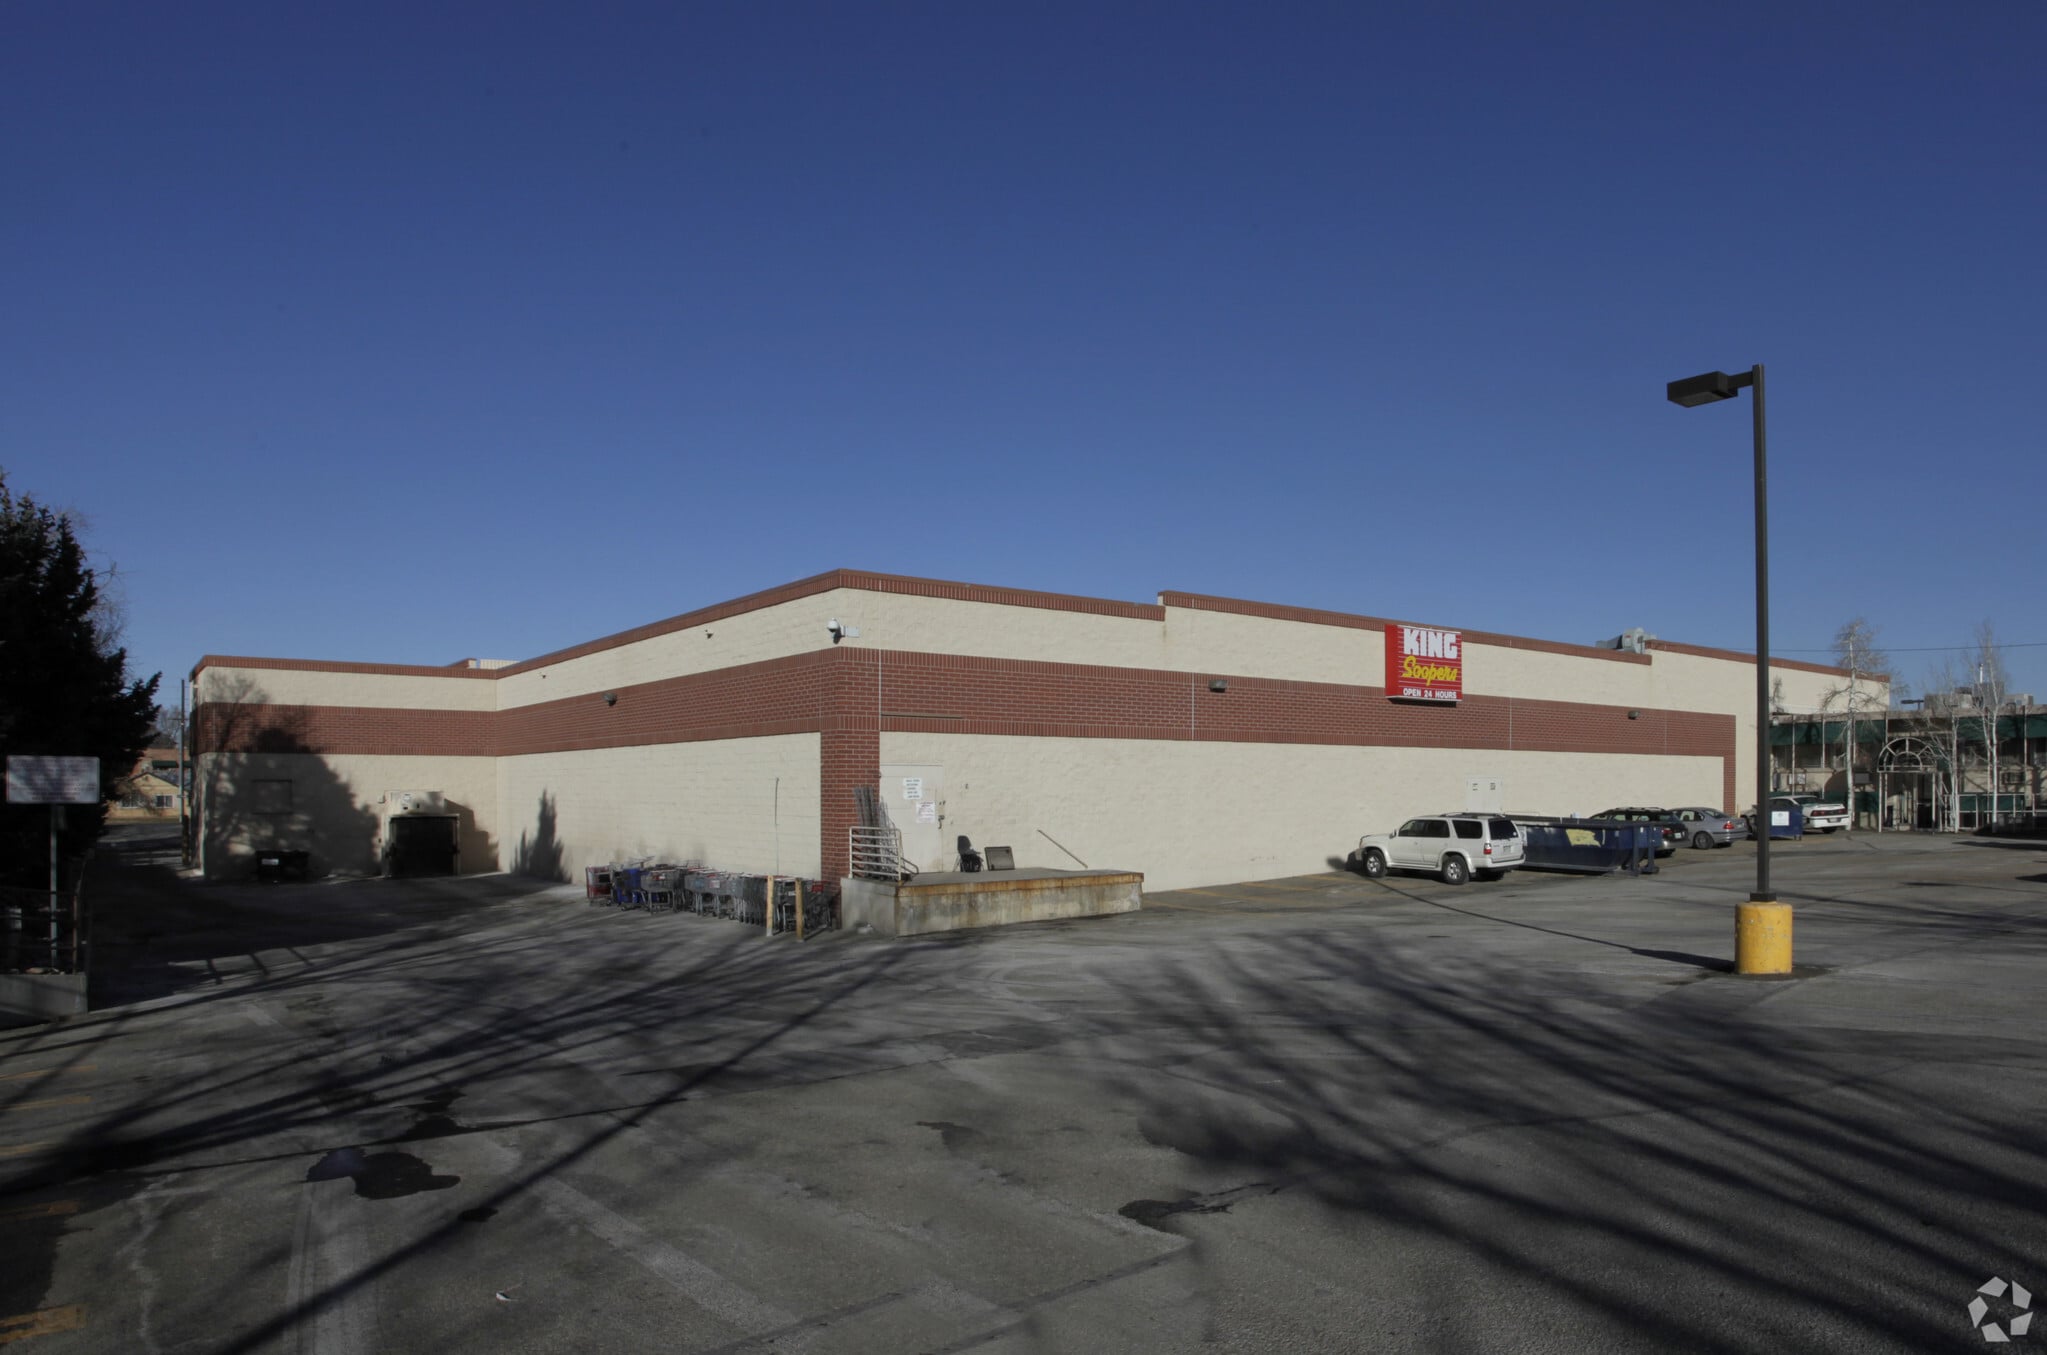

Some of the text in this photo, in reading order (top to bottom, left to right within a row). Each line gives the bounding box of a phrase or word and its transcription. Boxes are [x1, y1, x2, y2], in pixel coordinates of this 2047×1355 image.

[1403, 628, 1458, 659] KING
[1402, 655, 1458, 686] Soopers
[1403, 687, 1457, 699] OPEN 24 HOURS
